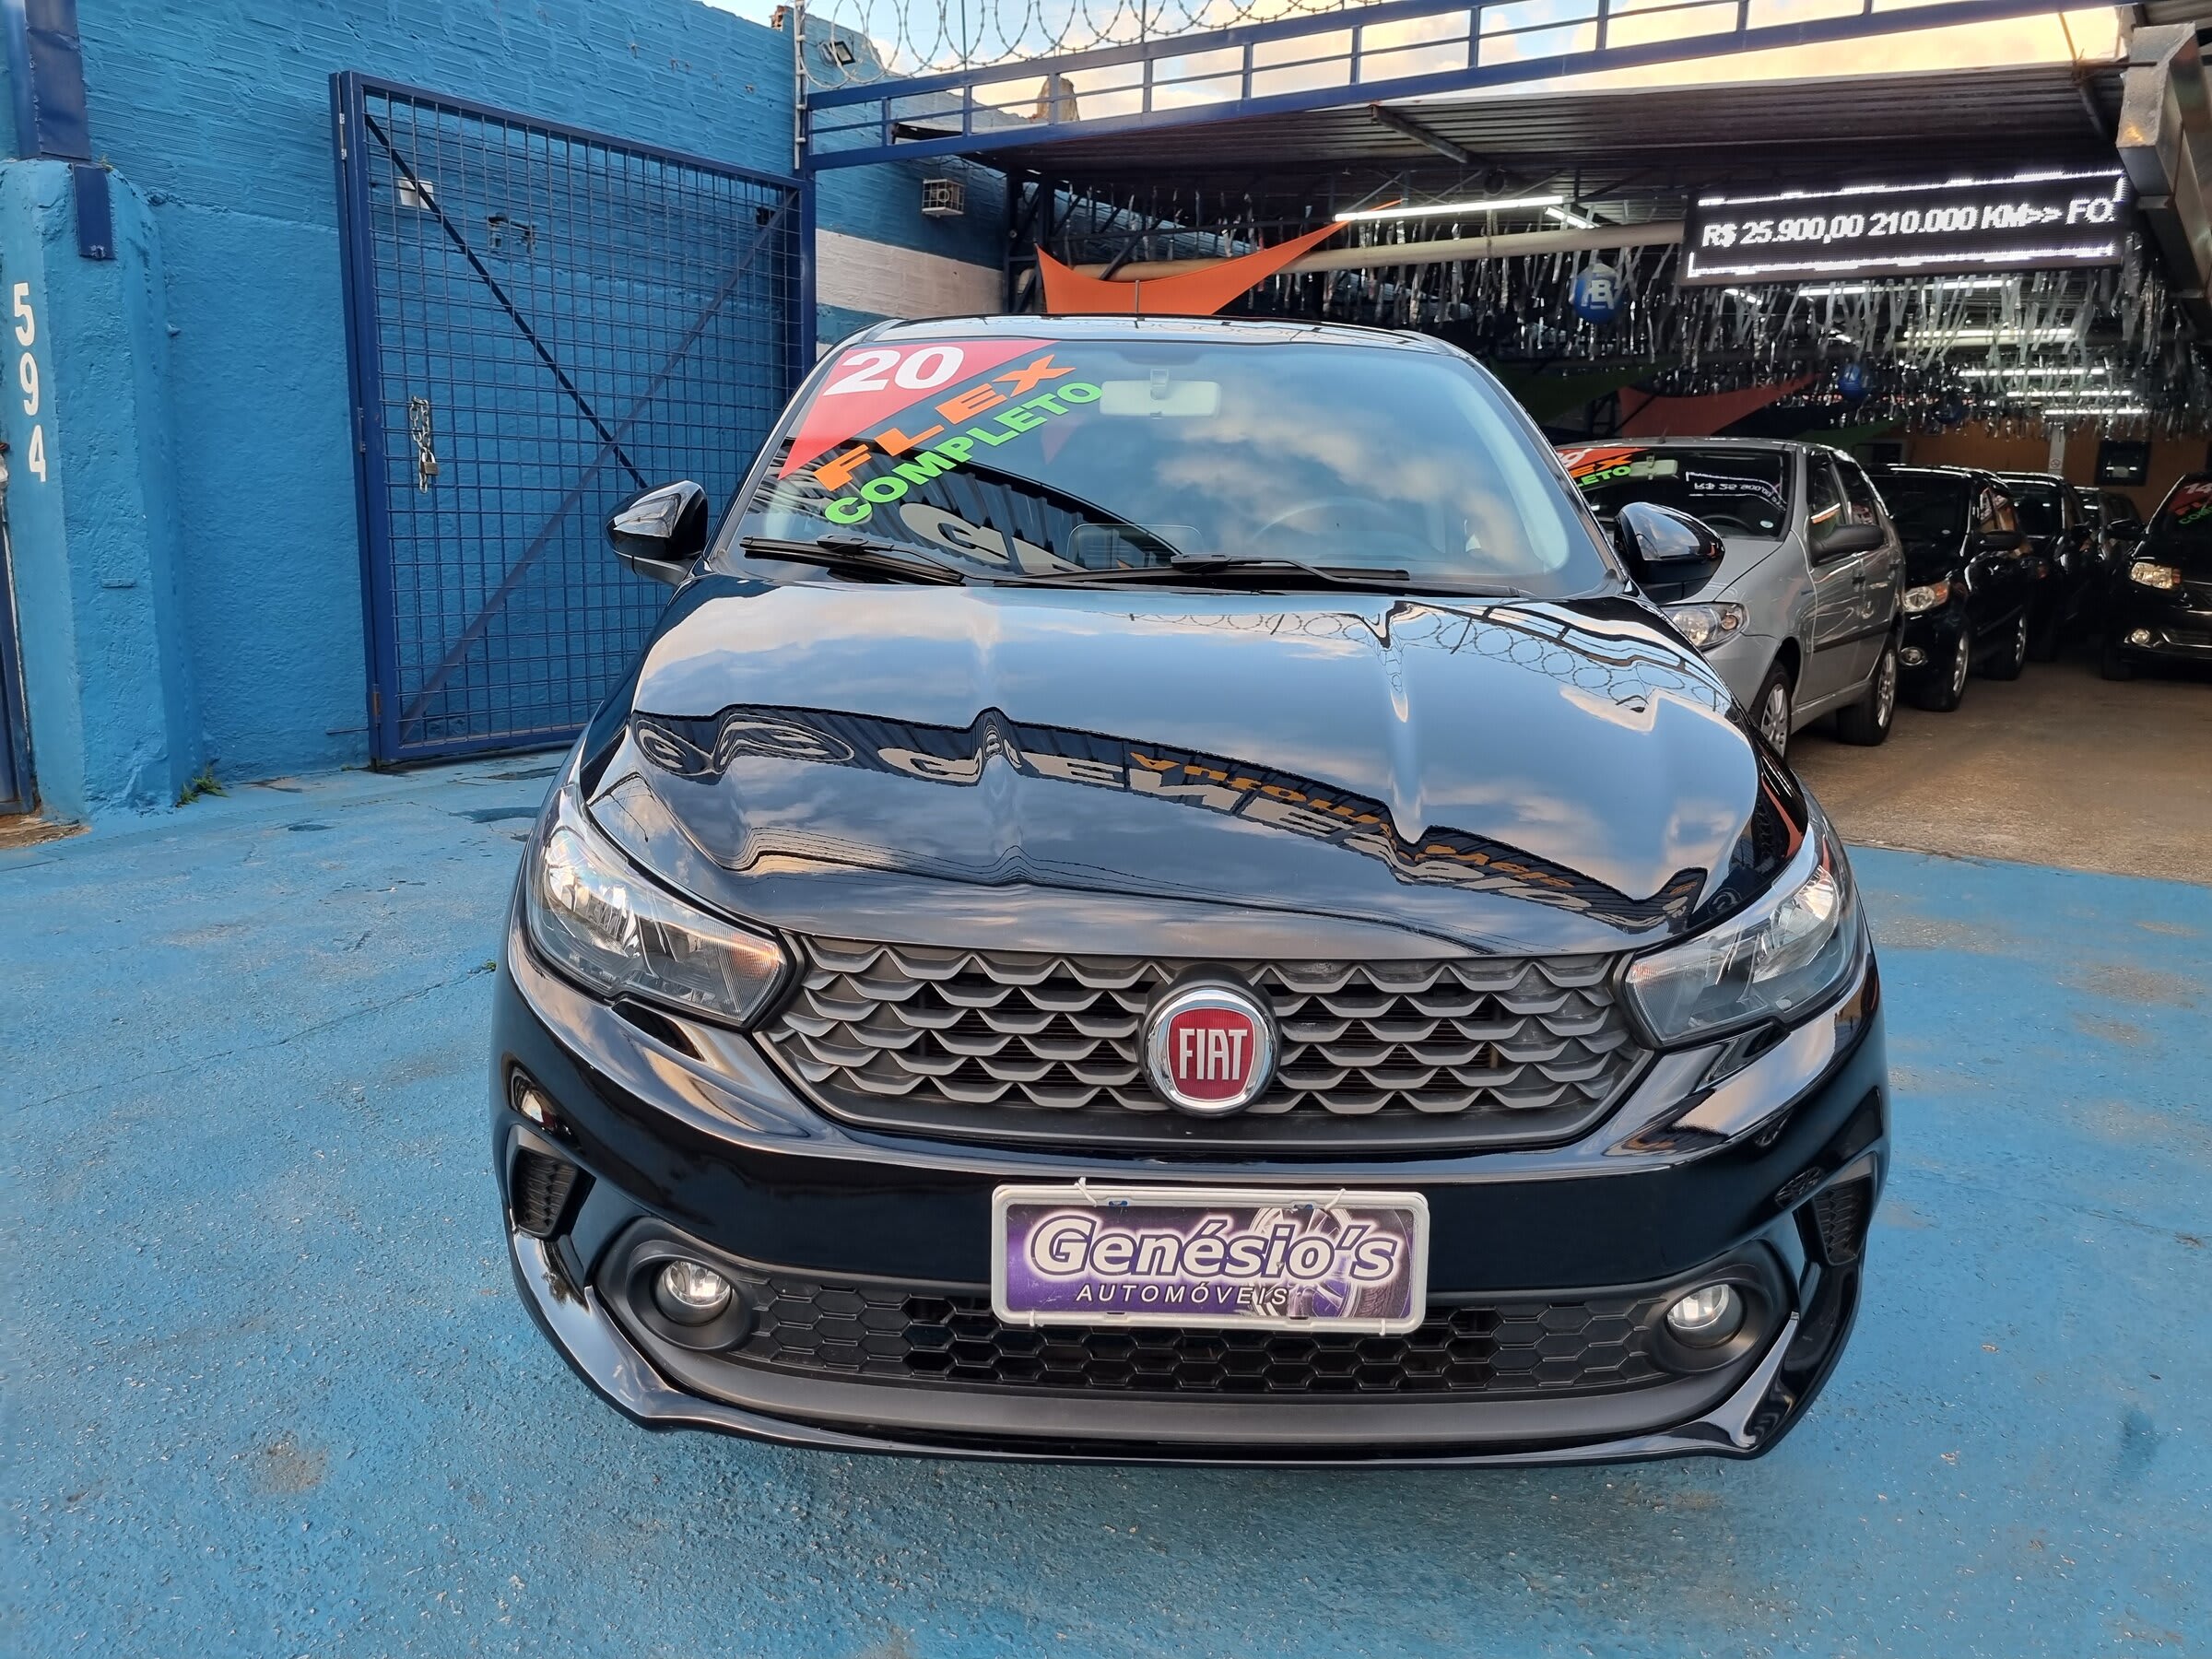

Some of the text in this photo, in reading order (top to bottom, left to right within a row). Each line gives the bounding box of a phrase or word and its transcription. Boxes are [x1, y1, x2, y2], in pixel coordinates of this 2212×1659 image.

[1702, 223, 1737, 247] R$
[1740, 214, 1865, 243] 25.900,00
[1867, 206, 1979, 236] 210.000
[2065, 197, 2117, 224] FO
[823, 346, 964, 396] 20
[813, 354, 1077, 491] FLEX
[825, 382, 1103, 524] COMPLETO
[1569, 454, 1632, 478] EX
[1179, 1028, 1248, 1080] FIAT
[1030, 1214, 1398, 1282] Genésio's
[1075, 1280, 1289, 1305] AUTOMÓVEIS
